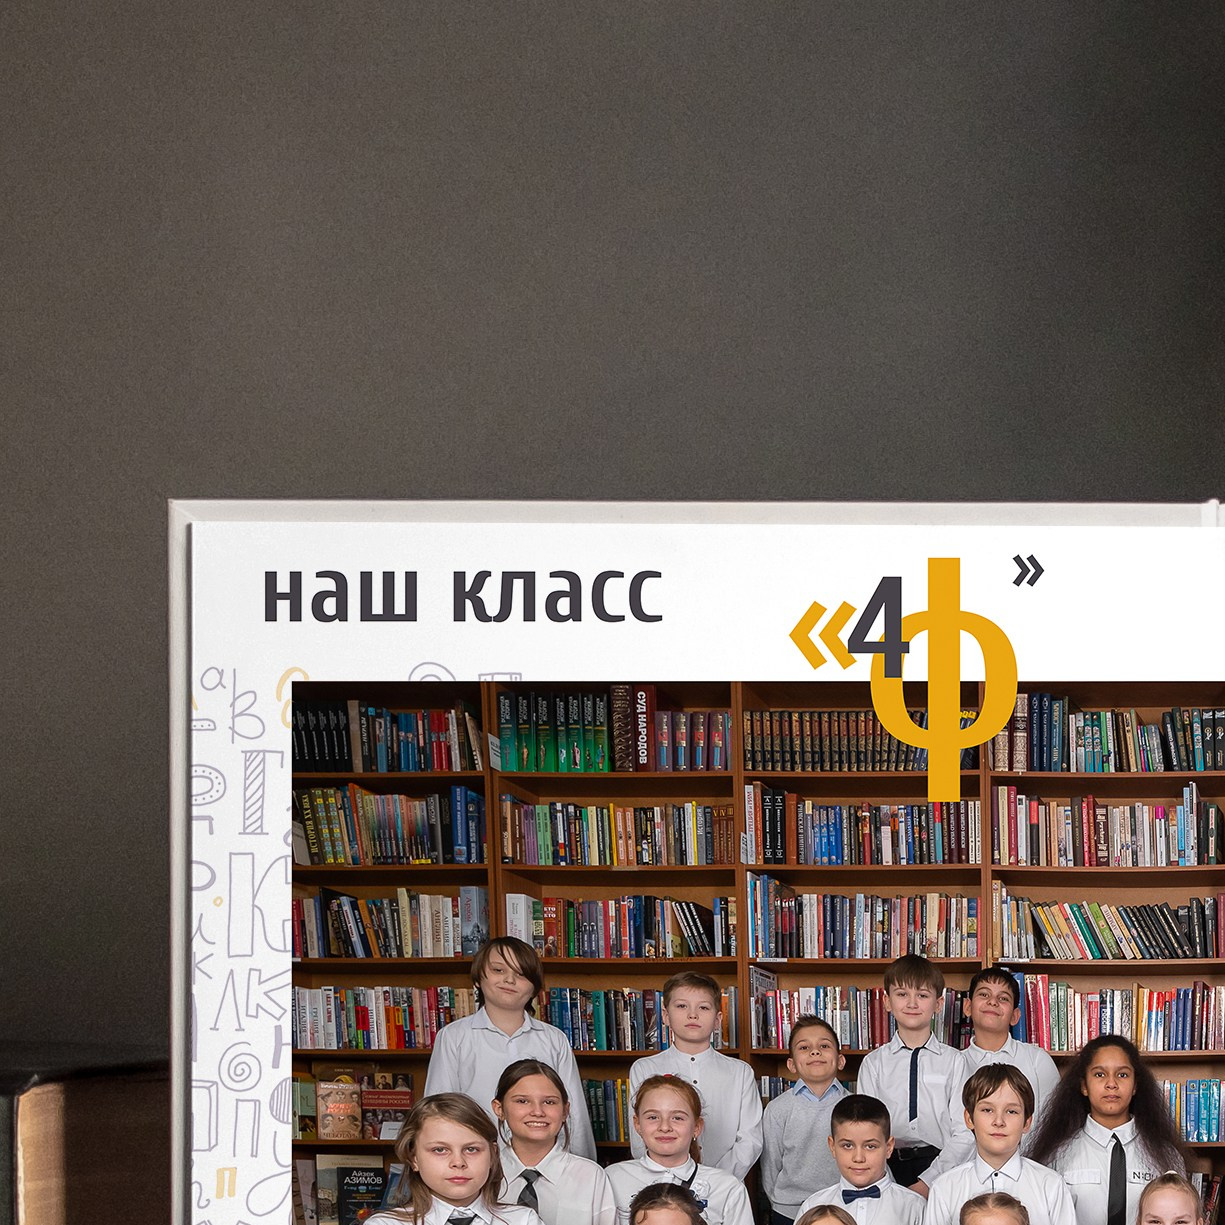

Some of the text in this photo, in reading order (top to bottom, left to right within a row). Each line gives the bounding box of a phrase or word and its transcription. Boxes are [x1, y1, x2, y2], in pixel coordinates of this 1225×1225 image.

[264, 568, 419, 622] наш
[452, 568, 664, 624] класс
[636, 691, 648, 764] СУД НАРОДОВ
[307, 820, 318, 852] ИСТОРИЯ
[344, 1176, 383, 1185] АЗИМОВ
